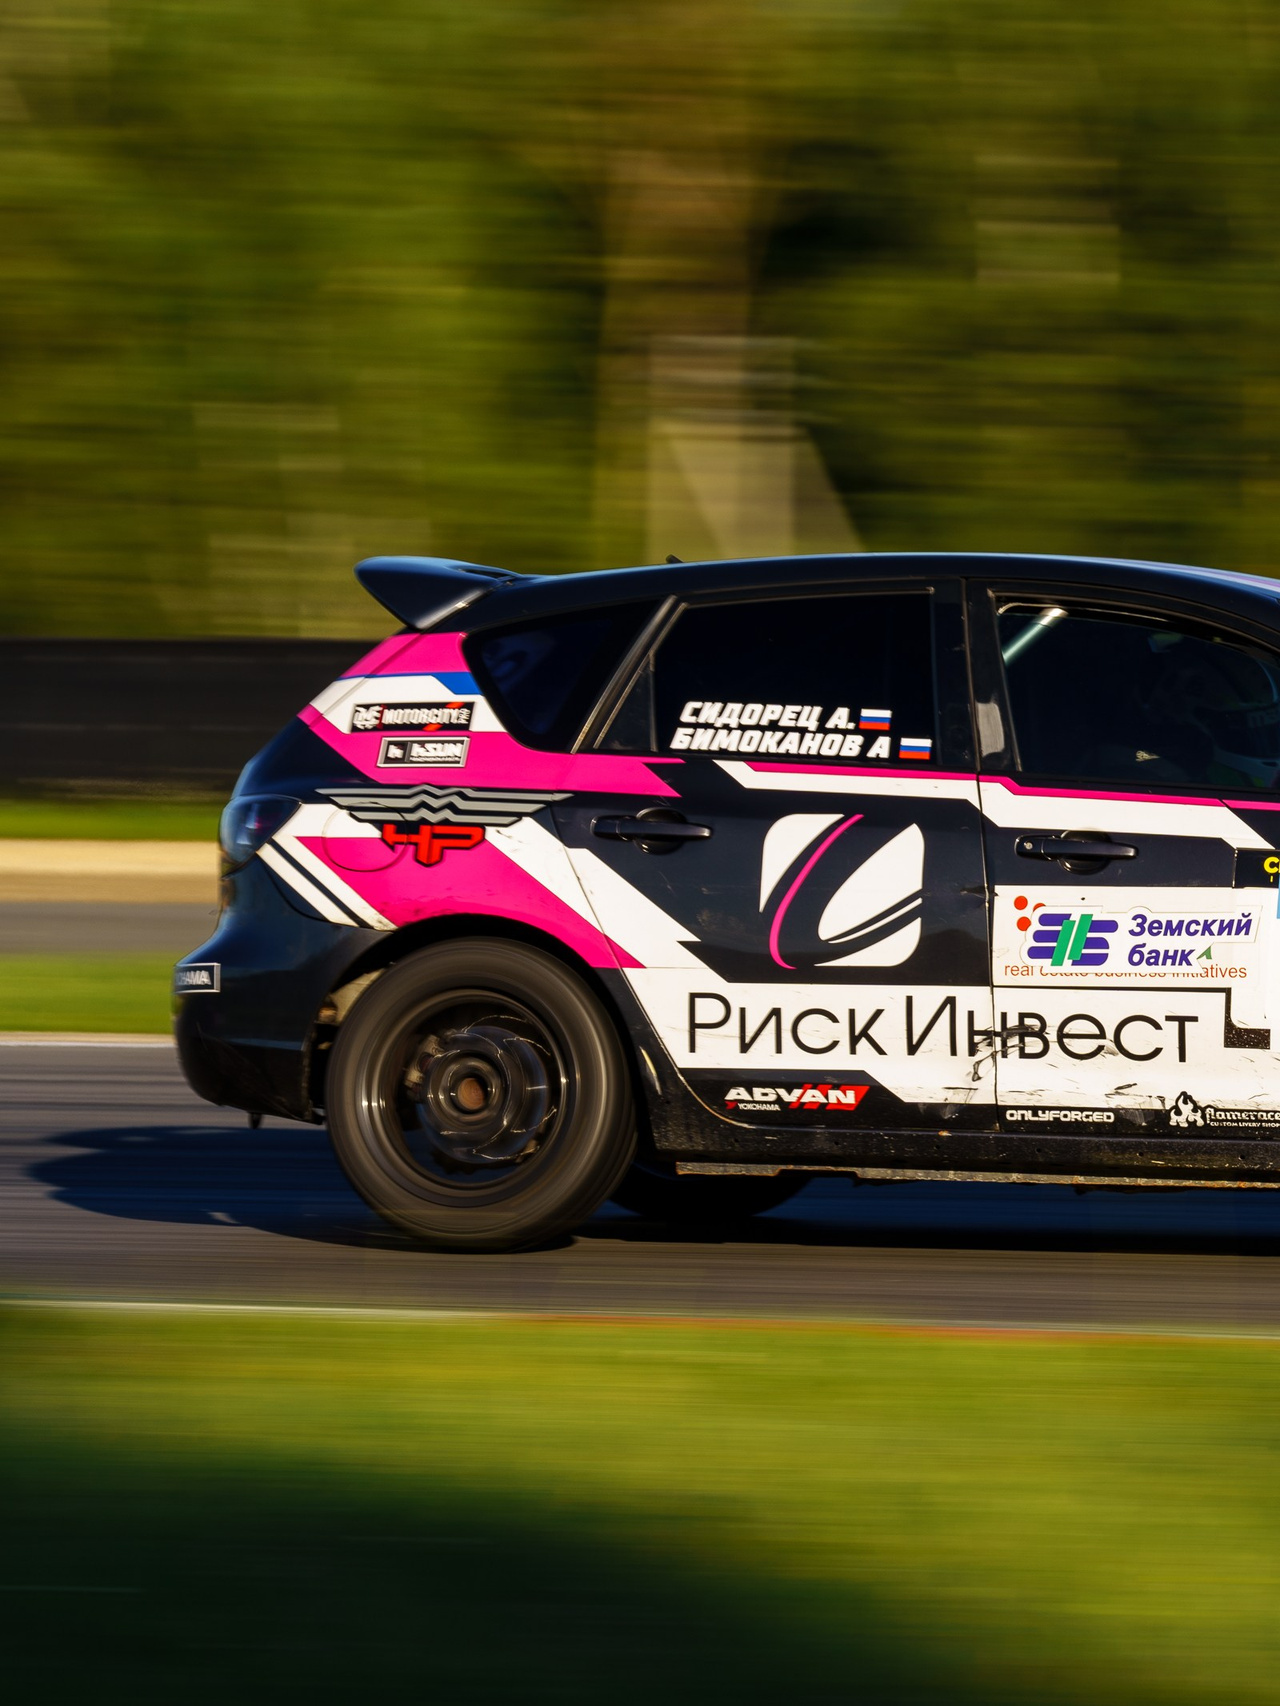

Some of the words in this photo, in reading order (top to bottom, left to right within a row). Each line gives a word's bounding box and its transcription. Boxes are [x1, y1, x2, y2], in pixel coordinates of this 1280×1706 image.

[381, 707, 461, 724] MOTORCITY
[679, 701, 822, 731] СИДОРЕЦ
[825, 707, 855, 729] А.
[669, 727, 864, 758] БИМОКАНОВ
[866, 736, 891, 758] А
[1128, 913, 1252, 937] Земский
[1128, 943, 1197, 967] банк
[688, 992, 888, 1055] Риск
[905, 995, 1199, 1062] Инвест
[724, 1087, 856, 1104] ADVAN
[738, 1102, 781, 1111] YOKOHAMA
[1006, 1110, 1115, 1122] ONLYFORGED
